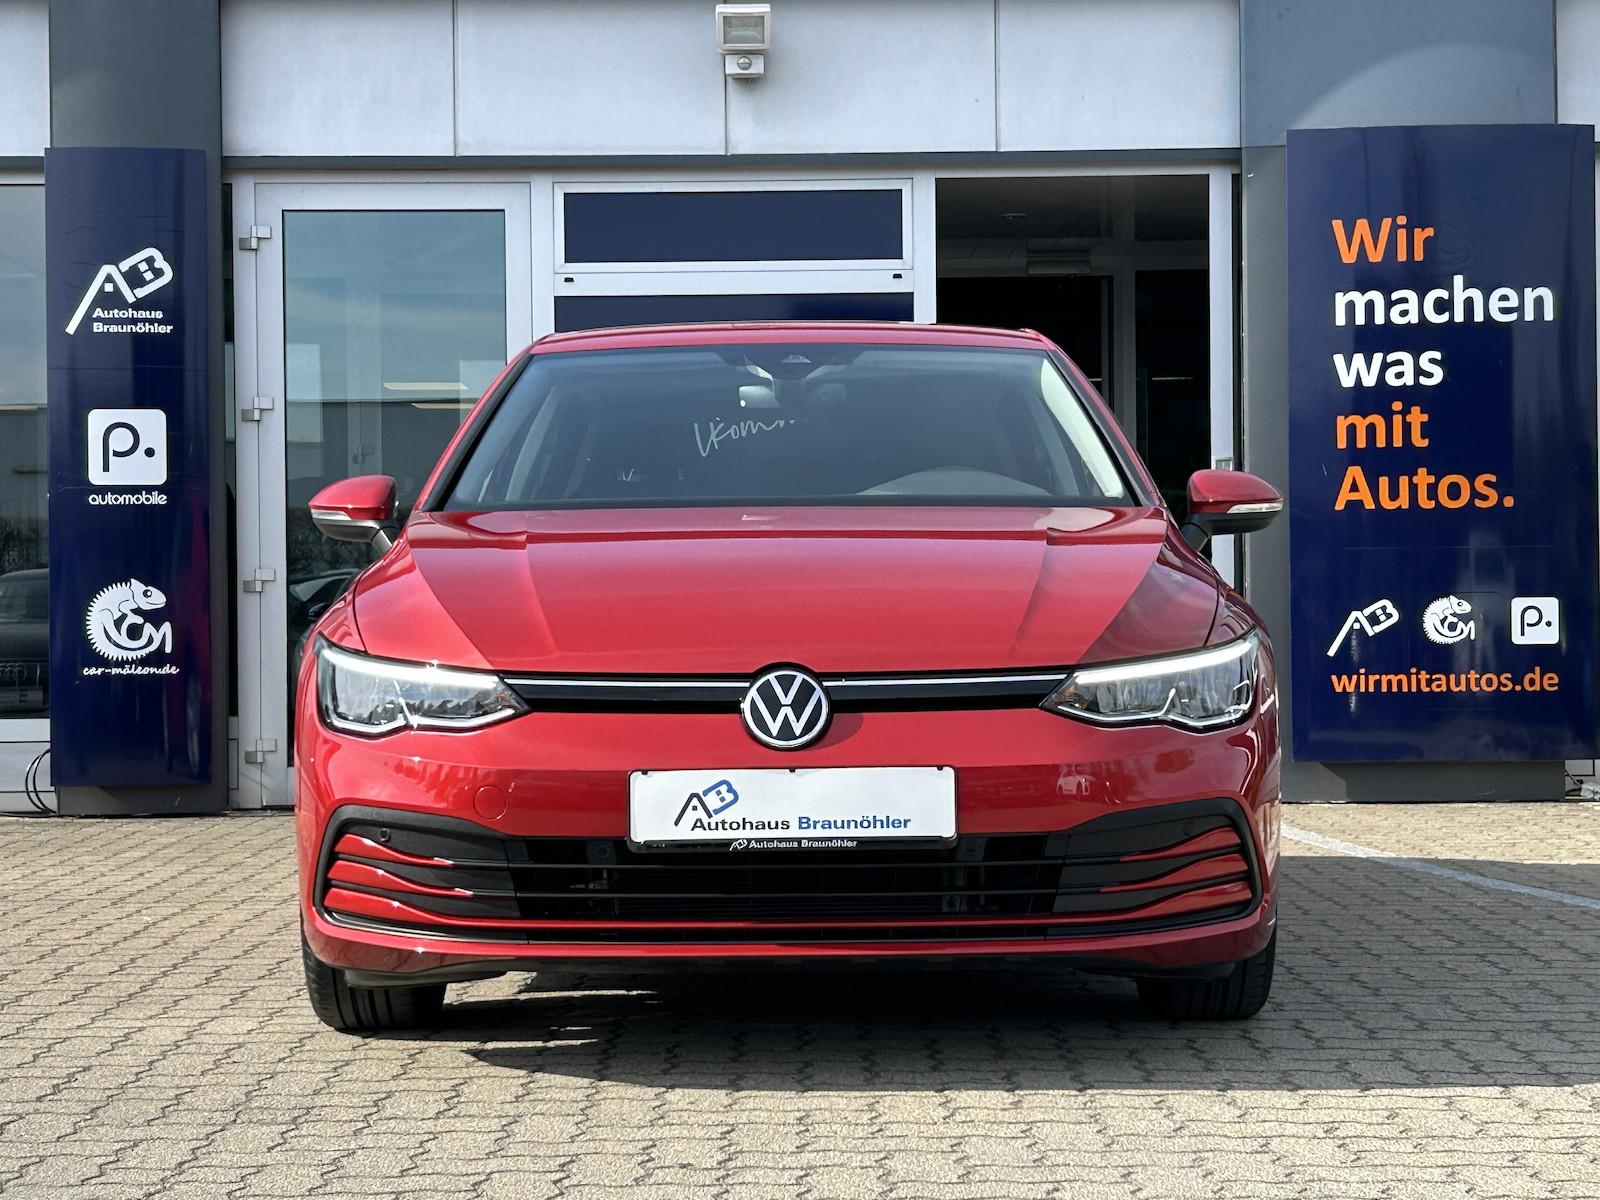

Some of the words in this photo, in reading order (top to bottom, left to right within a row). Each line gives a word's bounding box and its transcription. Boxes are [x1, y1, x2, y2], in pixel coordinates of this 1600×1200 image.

[1332, 215, 1435, 264] Wir
[92, 308, 164, 319] Autohaus
[1334, 274, 1555, 327] machen
[92, 322, 174, 334] Braunöhler
[1333, 350, 1444, 388] was
[1336, 401, 1429, 449] mit
[88, 490, 168, 506] automobile
[1334, 465, 1514, 511] Autos.
[1330, 666, 1560, 693] wirmitautos.de
[747, 671, 825, 740] VW
[690, 816, 791, 832] Autohaus
[797, 814, 912, 831] Braunöhler
[748, 839, 799, 849] Autohaus
[801, 838, 858, 849] Braunöhler
